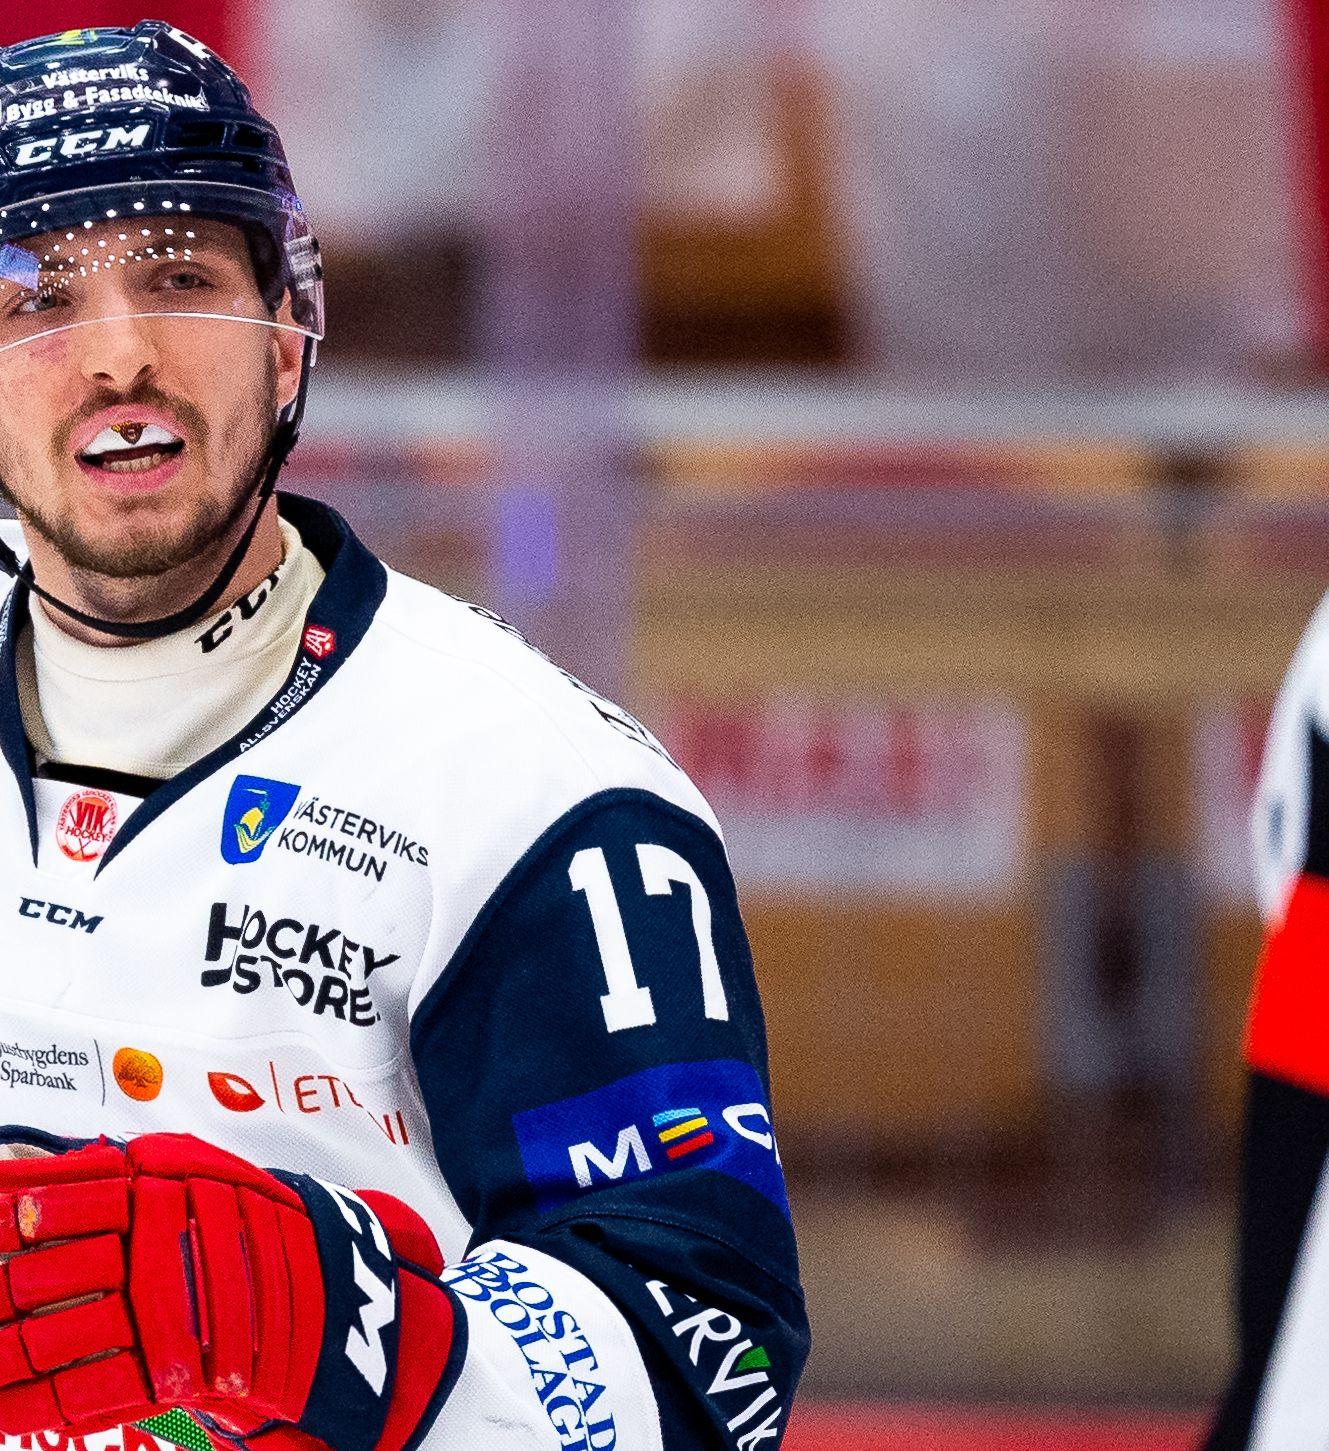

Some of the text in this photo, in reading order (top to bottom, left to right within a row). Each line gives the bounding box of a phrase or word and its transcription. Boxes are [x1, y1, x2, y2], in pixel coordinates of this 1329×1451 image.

[41, 62, 149, 89] Västerviks
[5, 98, 57, 123] Bygg
[63, 90, 79, 110] &
[14, 123, 150, 166] CCM
[270, 656, 313, 714] HOCKEY
[239, 664, 322, 753] ALLSVENSKAN
[76, 800, 110, 835] VIK
[277, 827, 388, 882] KOMMUN
[17, 896, 105, 934] CCM
[204, 902, 401, 981] HOCKEY
[568, 843, 728, 1033] 17
[0, 1060, 78, 1090] Sparbank
